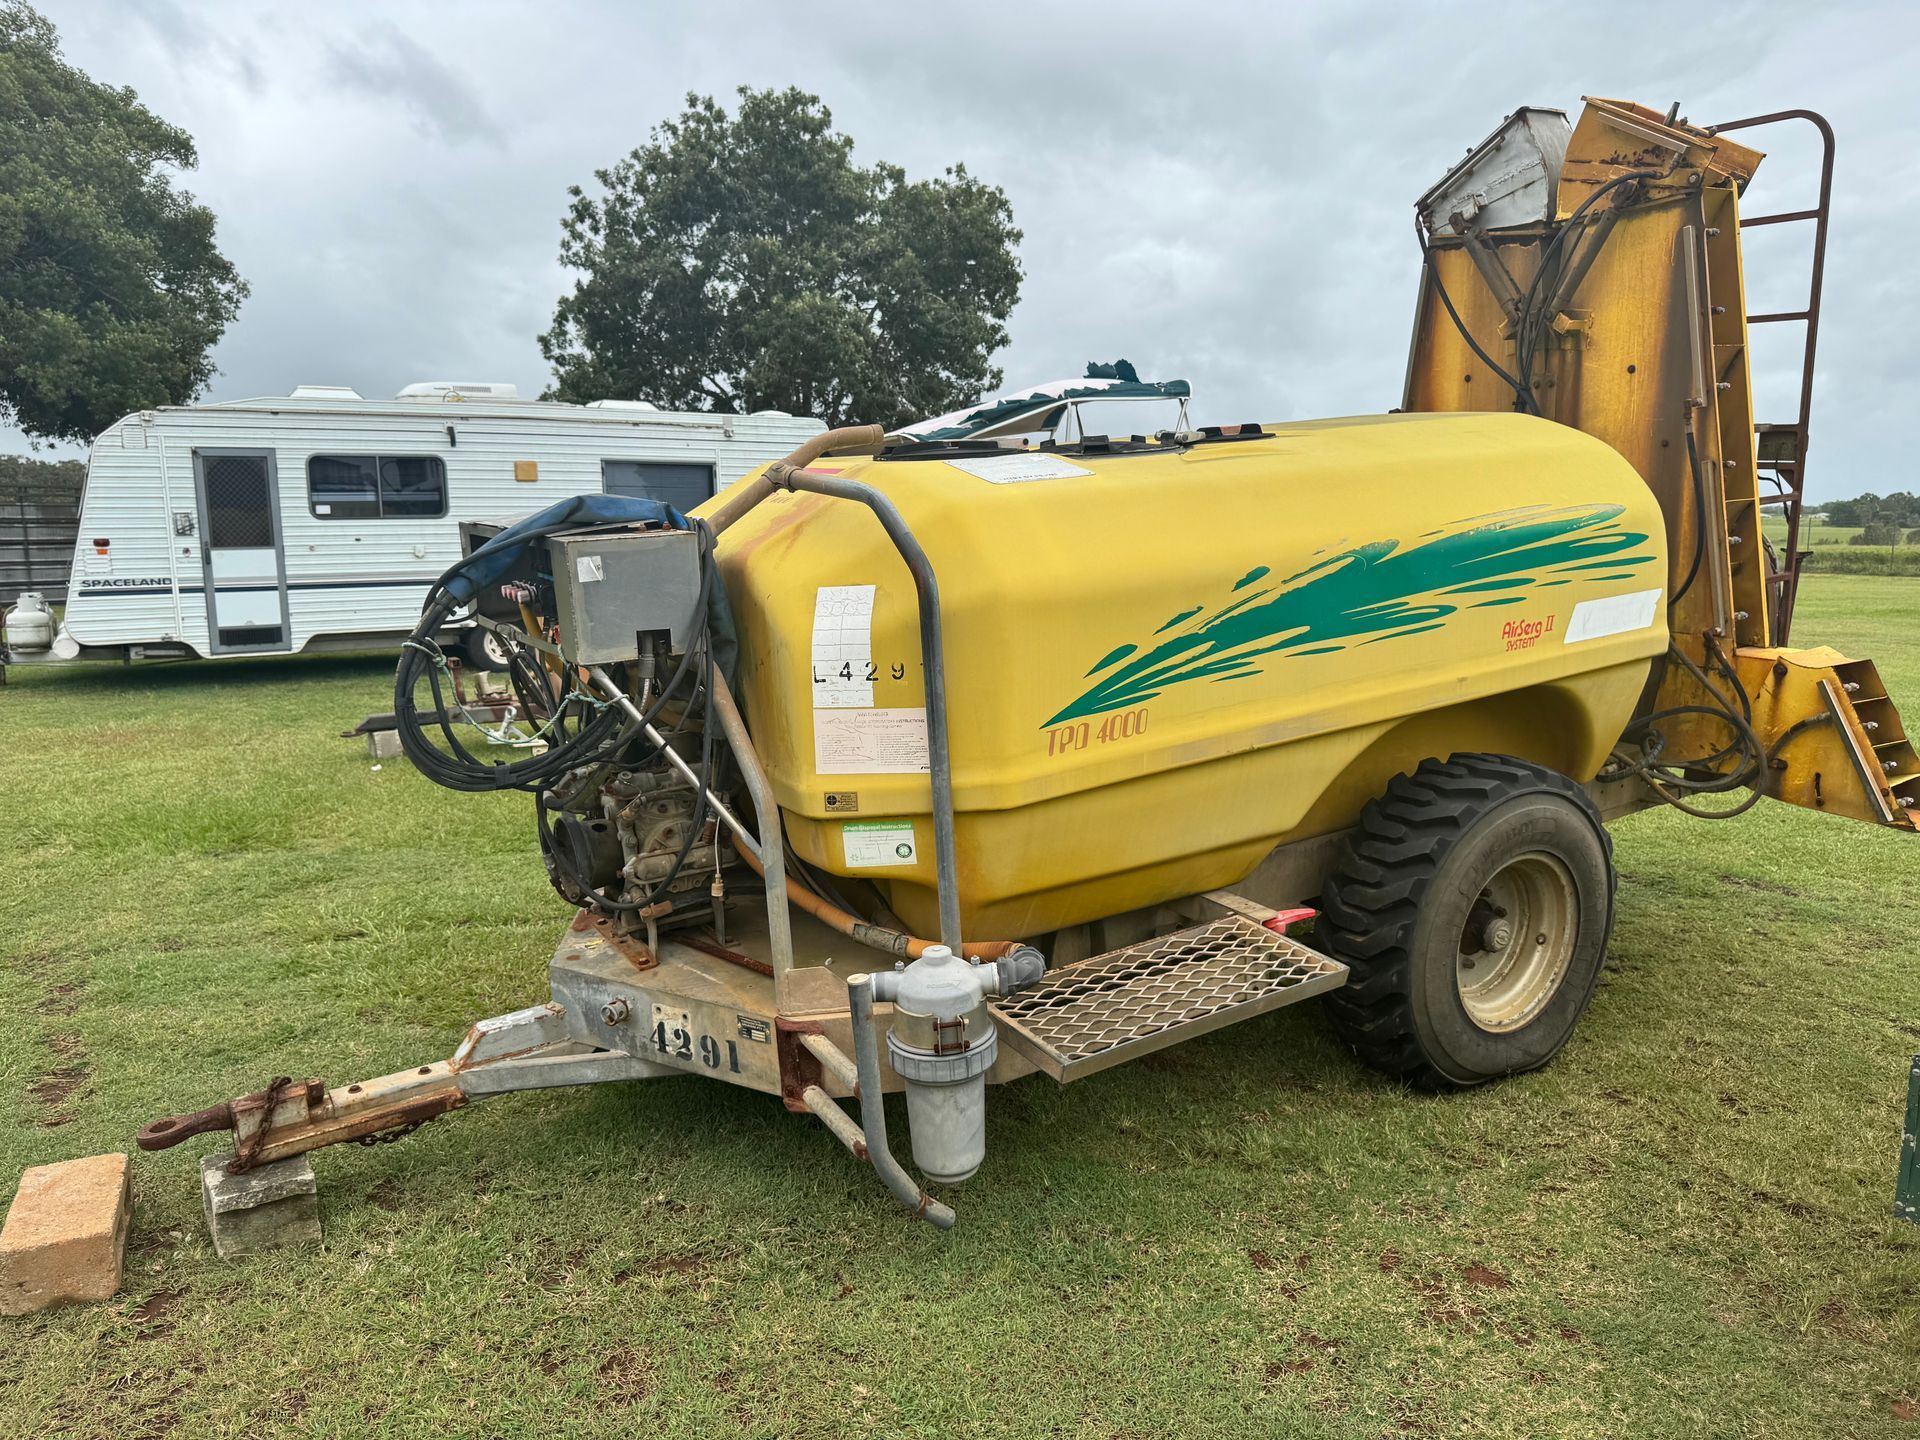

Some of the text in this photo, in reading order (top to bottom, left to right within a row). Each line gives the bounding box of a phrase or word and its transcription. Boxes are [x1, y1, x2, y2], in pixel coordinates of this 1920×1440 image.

[81, 577, 172, 587] SPACELAND
[1096, 708, 1149, 744] 4000
[650, 1021, 741, 1073] 4291
